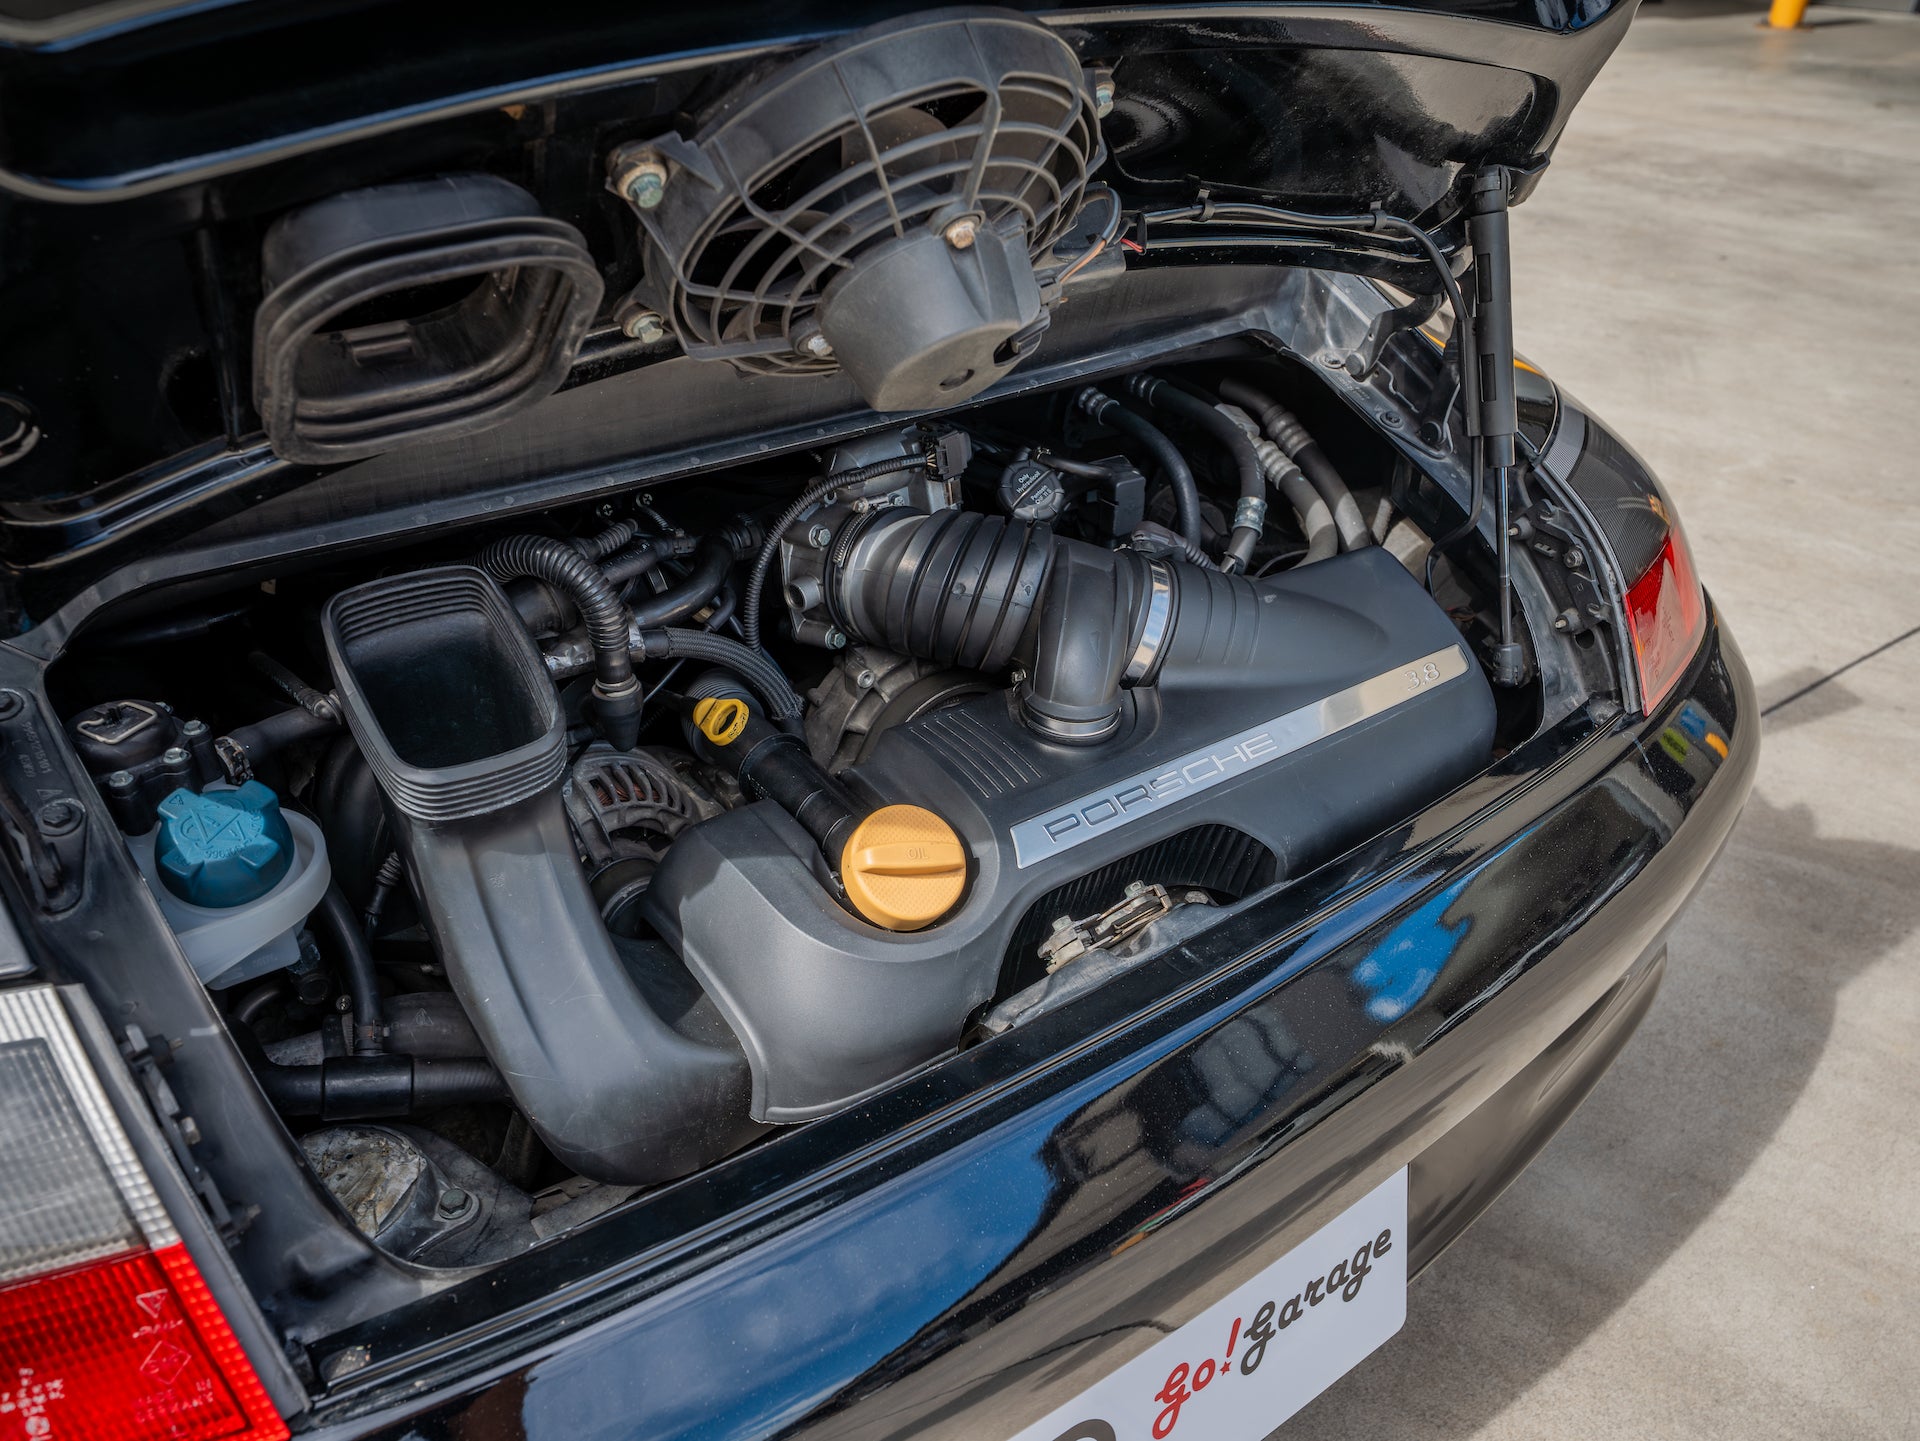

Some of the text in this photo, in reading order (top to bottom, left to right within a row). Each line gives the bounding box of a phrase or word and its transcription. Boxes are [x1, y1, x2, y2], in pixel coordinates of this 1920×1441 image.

[1042, 662, 1441, 844] PORSCHE 3.8
[906, 847, 929, 860] OIL
[1240, 1228, 1392, 1376] Garage
